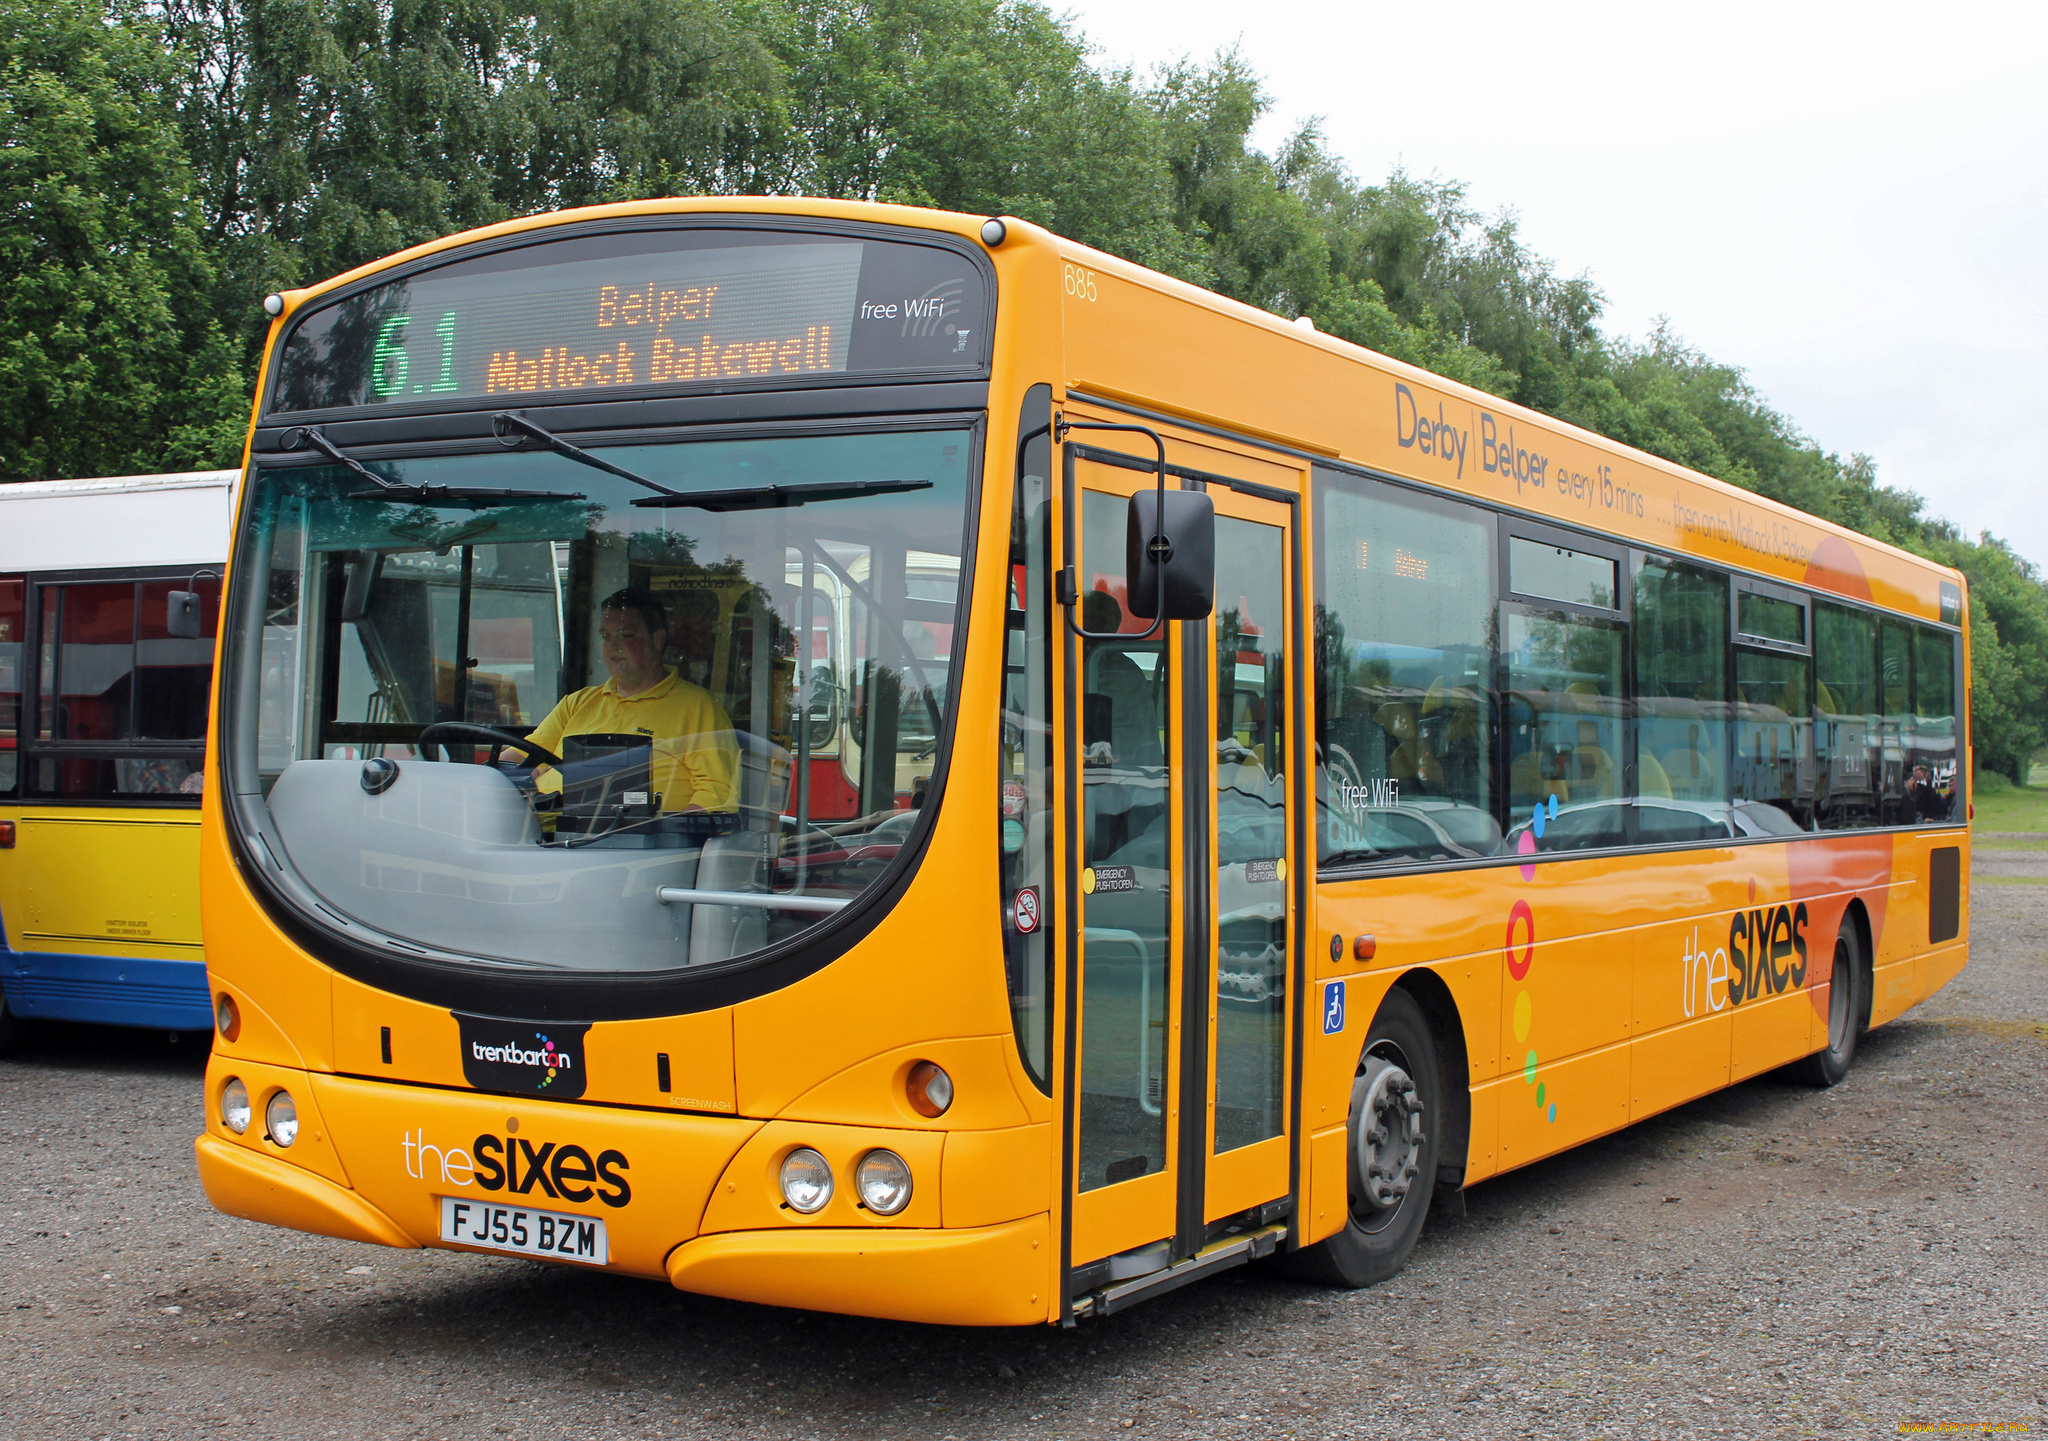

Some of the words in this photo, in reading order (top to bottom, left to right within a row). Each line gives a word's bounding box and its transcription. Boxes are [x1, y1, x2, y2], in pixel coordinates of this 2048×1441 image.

[1063, 264, 1097, 302] 685
[598, 282, 719, 338] Belper
[861, 300, 898, 320] free
[904, 298, 945, 318] WiFi
[373, 310, 458, 397] 6.1
[486, 342, 635, 394] Matlock
[650, 326, 832, 381] Bakewell
[1394, 382, 1468, 481] Derby
[1481, 411, 1549, 497] Belper
[1558, 467, 1595, 510] every
[1598, 463, 1614, 510] 15
[1616, 481, 1645, 519] mins
[1729, 506, 1771, 556] Matlock
[1341, 777, 1369, 809] free
[1371, 777, 1400, 809] WiFi
[1096, 868, 1128, 880] EMERGENCY
[1096, 880, 1110, 891] PUSH
[1119, 879, 1133, 889] OPEN
[472, 1040, 571, 1070] trentbarton
[669, 1096, 731, 1111] SCREENWASH
[452, 1203, 528, 1247] FJ55
[538, 1215, 596, 1258] BZM
